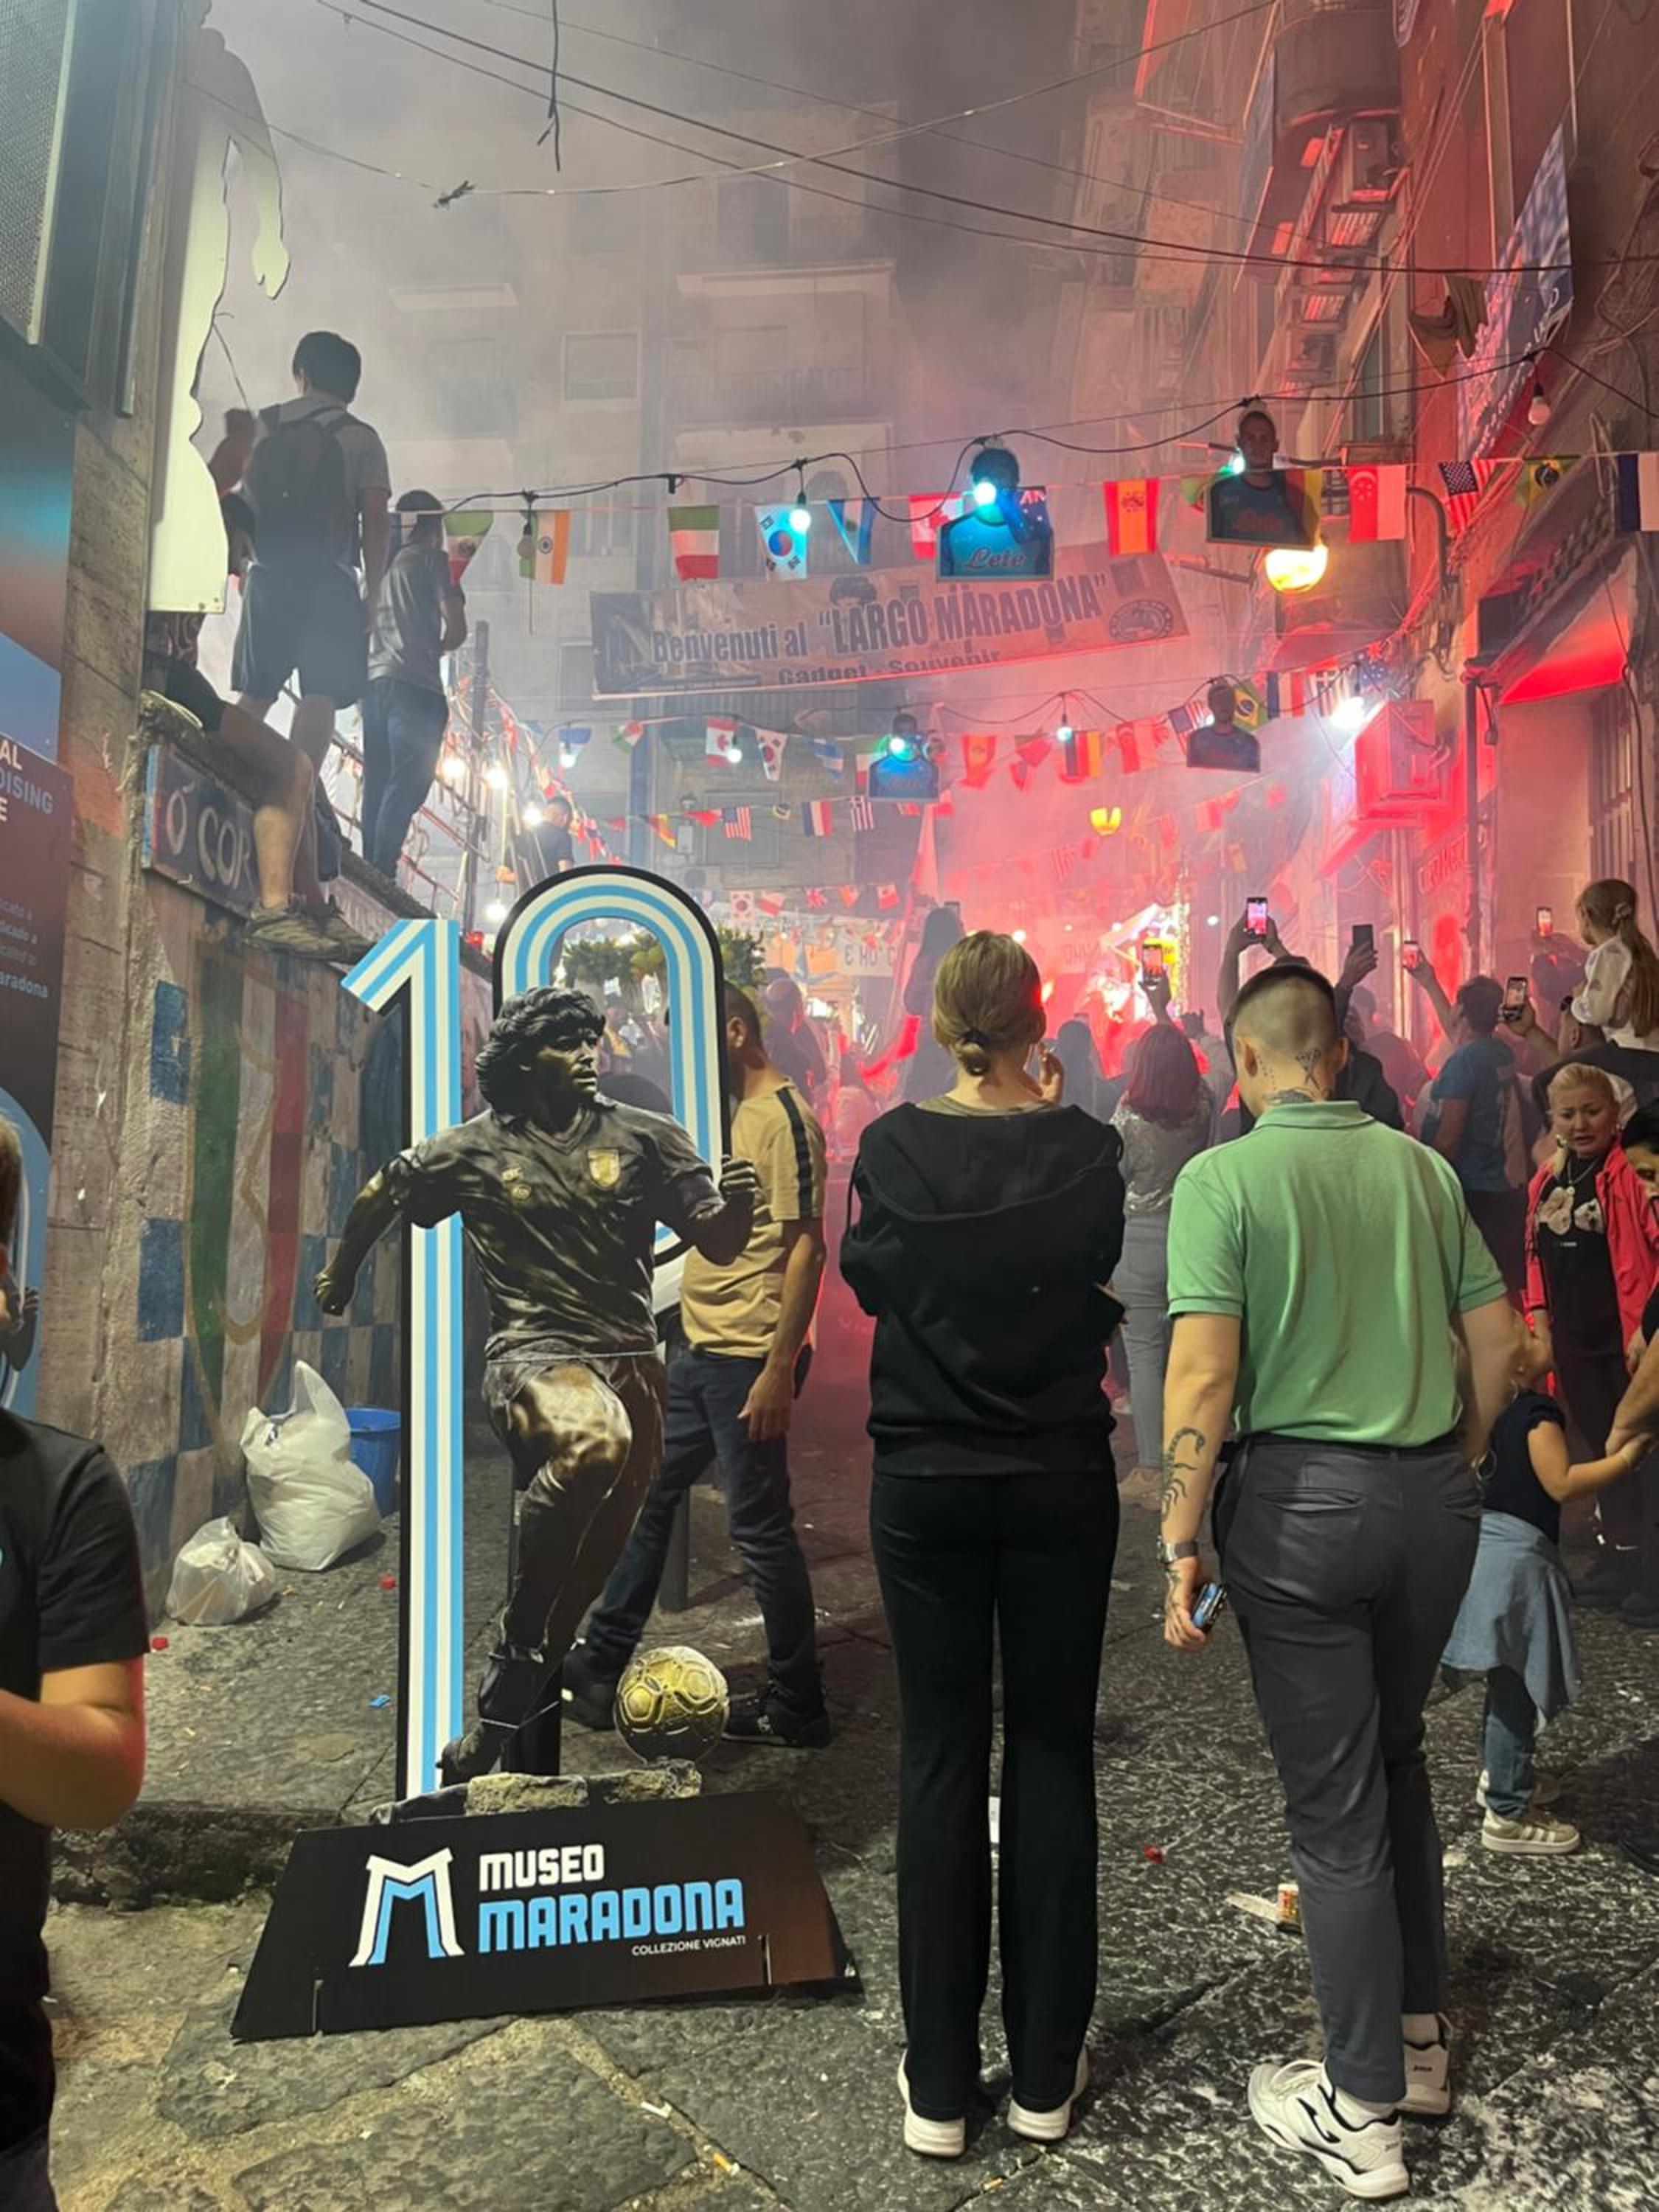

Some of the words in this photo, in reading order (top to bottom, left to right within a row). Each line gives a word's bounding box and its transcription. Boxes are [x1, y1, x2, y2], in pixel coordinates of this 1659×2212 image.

[653, 624, 777, 663] Benvenuti
[785, 622, 808, 656] al
[819, 598, 930, 654] "LARGO
[933, 574, 1106, 641] MARADONA"
[479, 1843, 605, 1892] MUSEO
[479, 1878, 745, 1954] MARADONA
[632, 1940, 700, 1956] COLLEZIONE
[703, 1935, 746, 1950] VIGNATI
